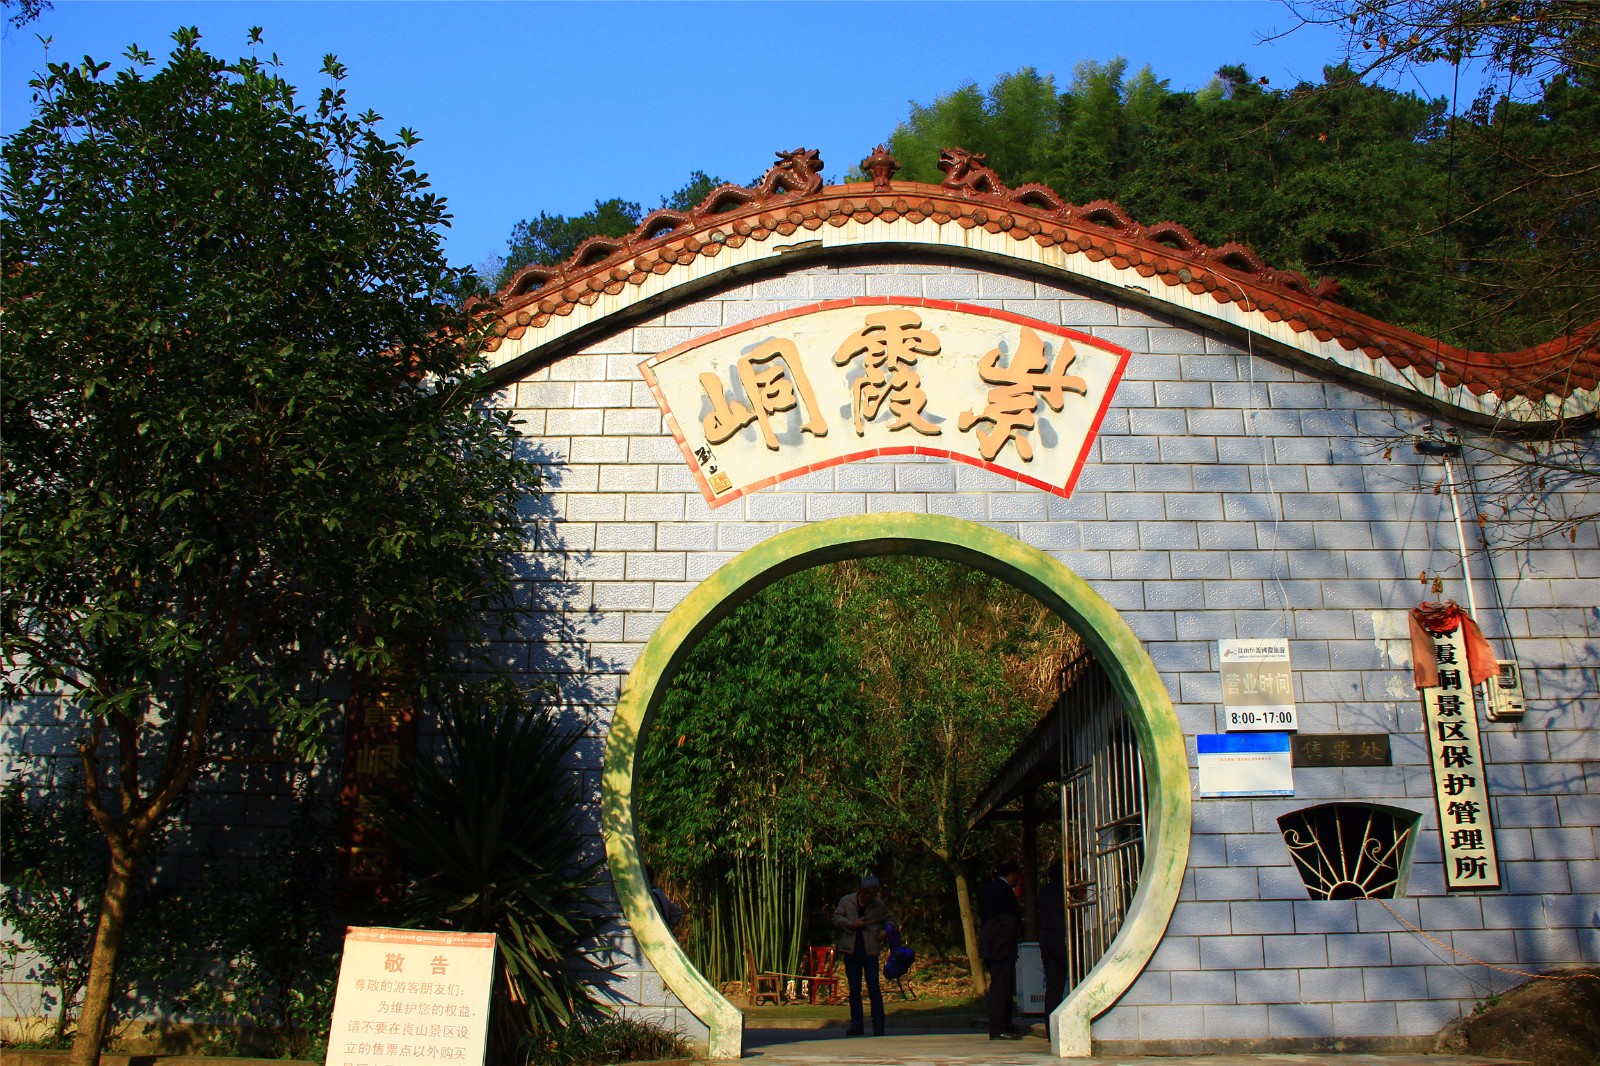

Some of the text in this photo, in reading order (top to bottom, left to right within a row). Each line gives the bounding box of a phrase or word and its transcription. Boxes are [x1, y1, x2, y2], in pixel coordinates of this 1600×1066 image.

[1226, 672, 1291, 695] 营业时间
[1231, 711, 1293, 724] 8:00-17:00
[1301, 740, 1384, 761] 售票处
[384, 952, 450, 976] 敬告
[347, 1019, 469, 1039] 请不要在崀山景区设
[343, 1041, 467, 1060] 立的售票点以外购买
